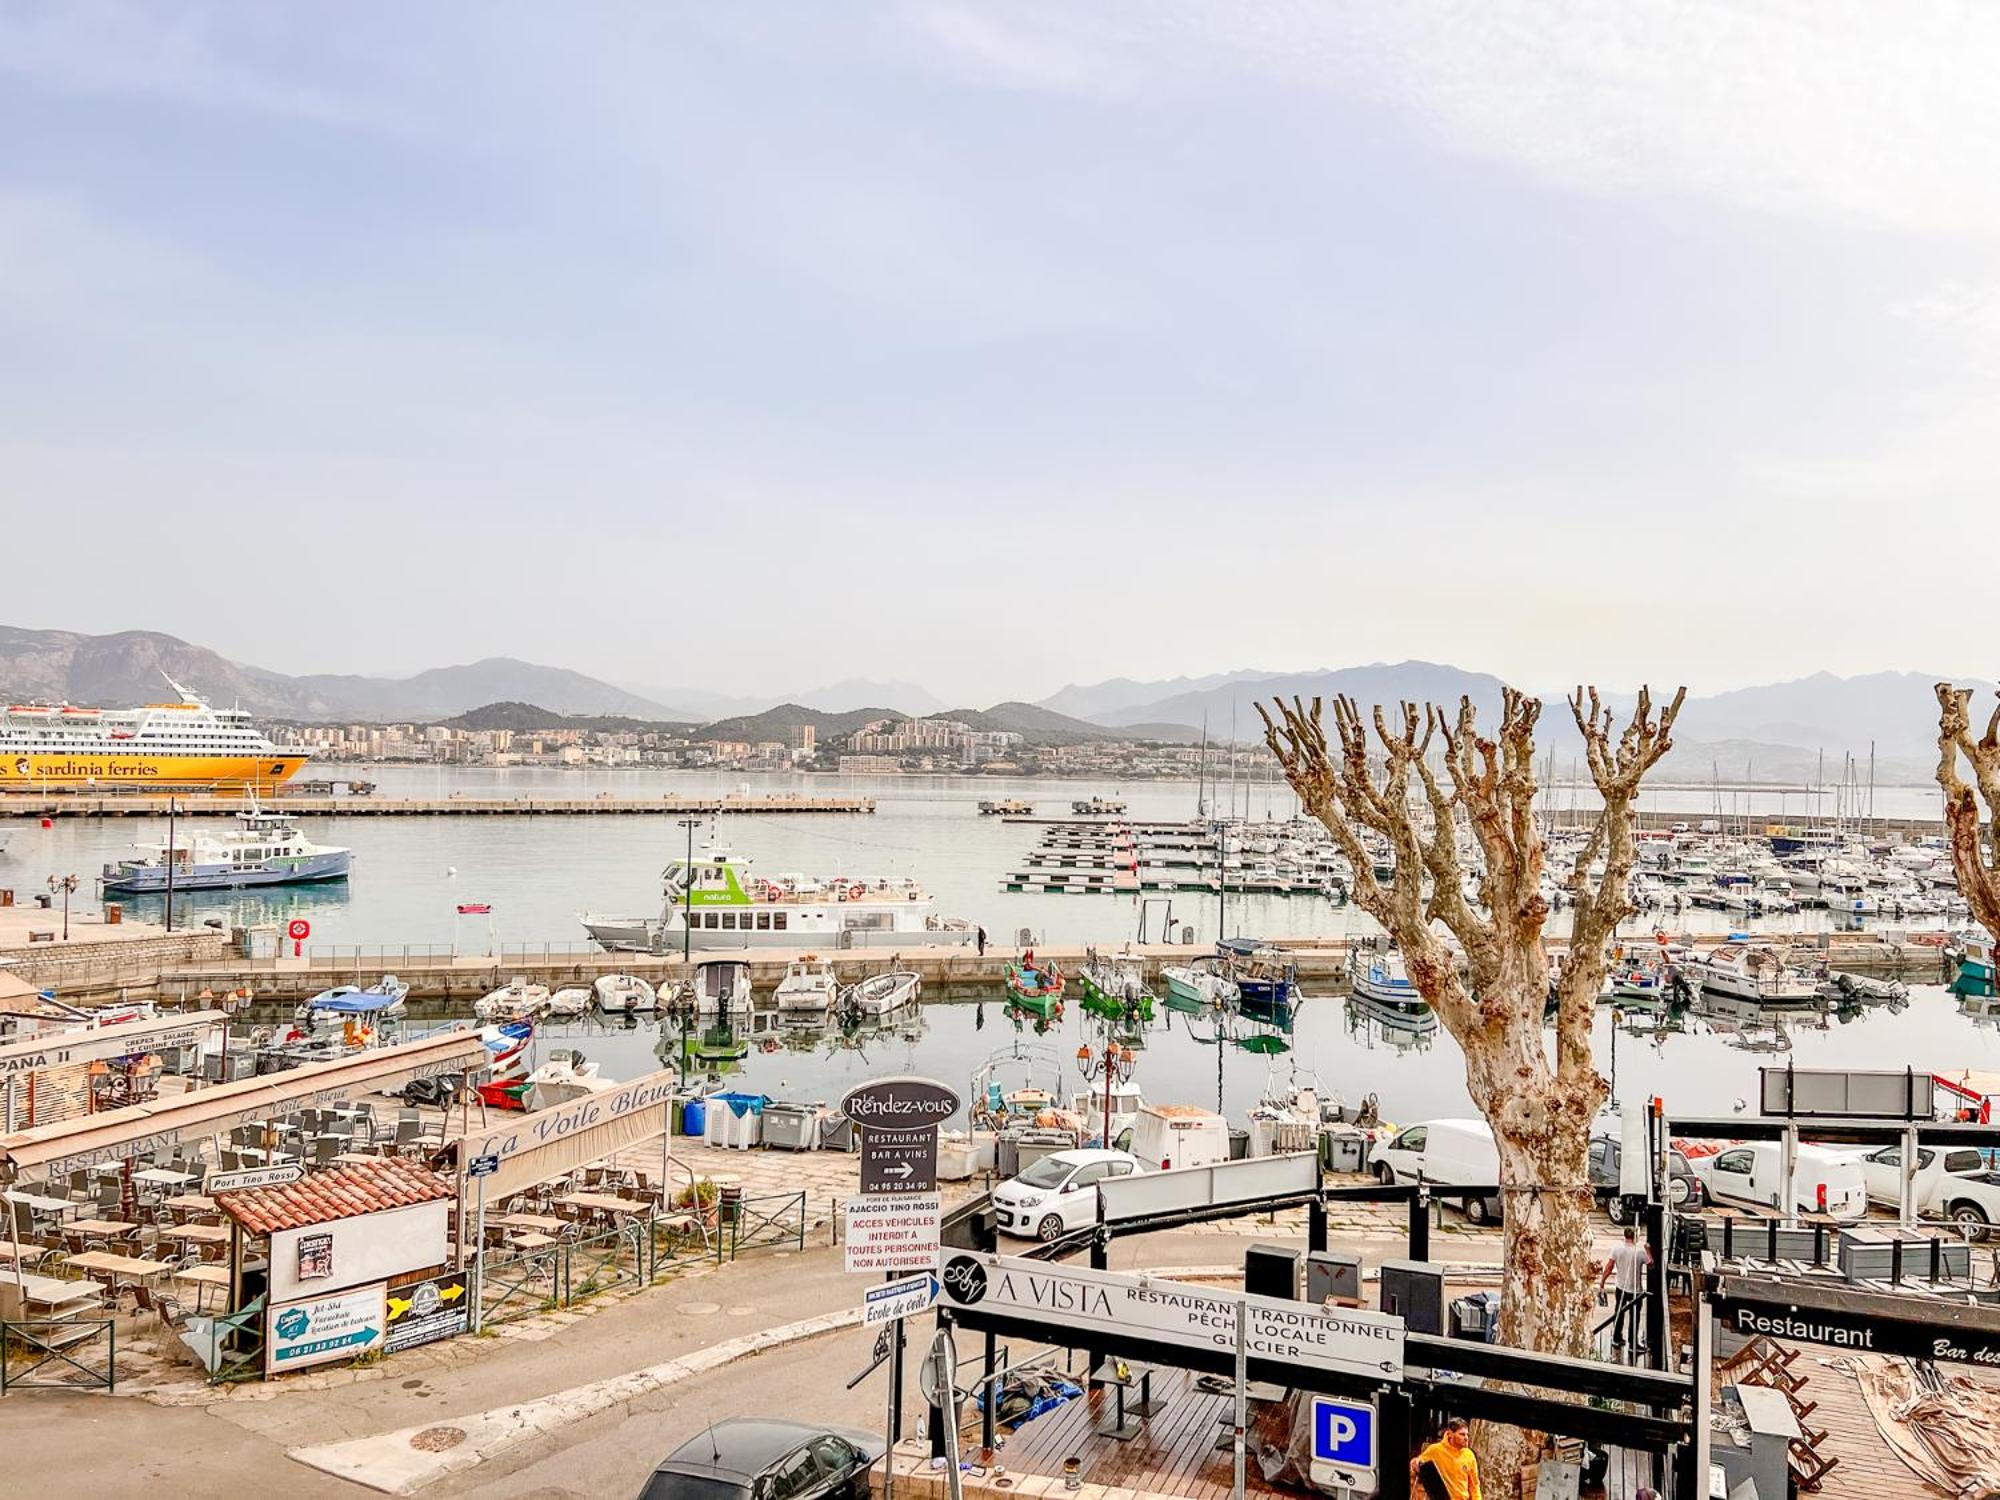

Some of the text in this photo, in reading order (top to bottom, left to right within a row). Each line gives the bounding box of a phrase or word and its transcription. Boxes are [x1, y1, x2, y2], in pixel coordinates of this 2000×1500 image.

[37, 761, 158, 775] sardinia ferries
[58, 1051, 70, 1063] II
[413, 1056, 469, 1079] PIZZERIA
[238, 1088, 347, 1122] La Voile Bleue
[850, 1094, 953, 1116] Rendez-vous
[482, 1081, 673, 1156] La Voile Bleue
[868, 1133, 932, 1143] RESTAURANT
[48, 1129, 184, 1177] RESTAURANT
[871, 1151, 891, 1160] BAR
[905, 1150, 928, 1159] VINS
[214, 1172, 294, 1188] Port Tino Rossi
[868, 1183, 879, 1191] 04
[893, 1183, 904, 1191] 20
[905, 1182, 916, 1190] 34
[849, 1202, 939, 1214] AJACCIO TINO ROSSI
[868, 1231, 909, 1241] INTERDIT
[847, 1242, 940, 1255] TOUTES PERSONNES
[852, 1258, 874, 1268] NON
[997, 1272, 1113, 1317] A VISTA
[867, 1302, 892, 1322] Ecole
[893, 1299, 905, 1316] de
[1127, 1289, 1396, 1341] RESTAURAN TRADITIONNEL
[1188, 1309, 1327, 1345] PÊCH LOCALE
[1737, 1308, 1873, 1348] Restaurant
[1933, 1338, 1968, 1359] Bar
[1330, 1413, 1357, 1452] P
